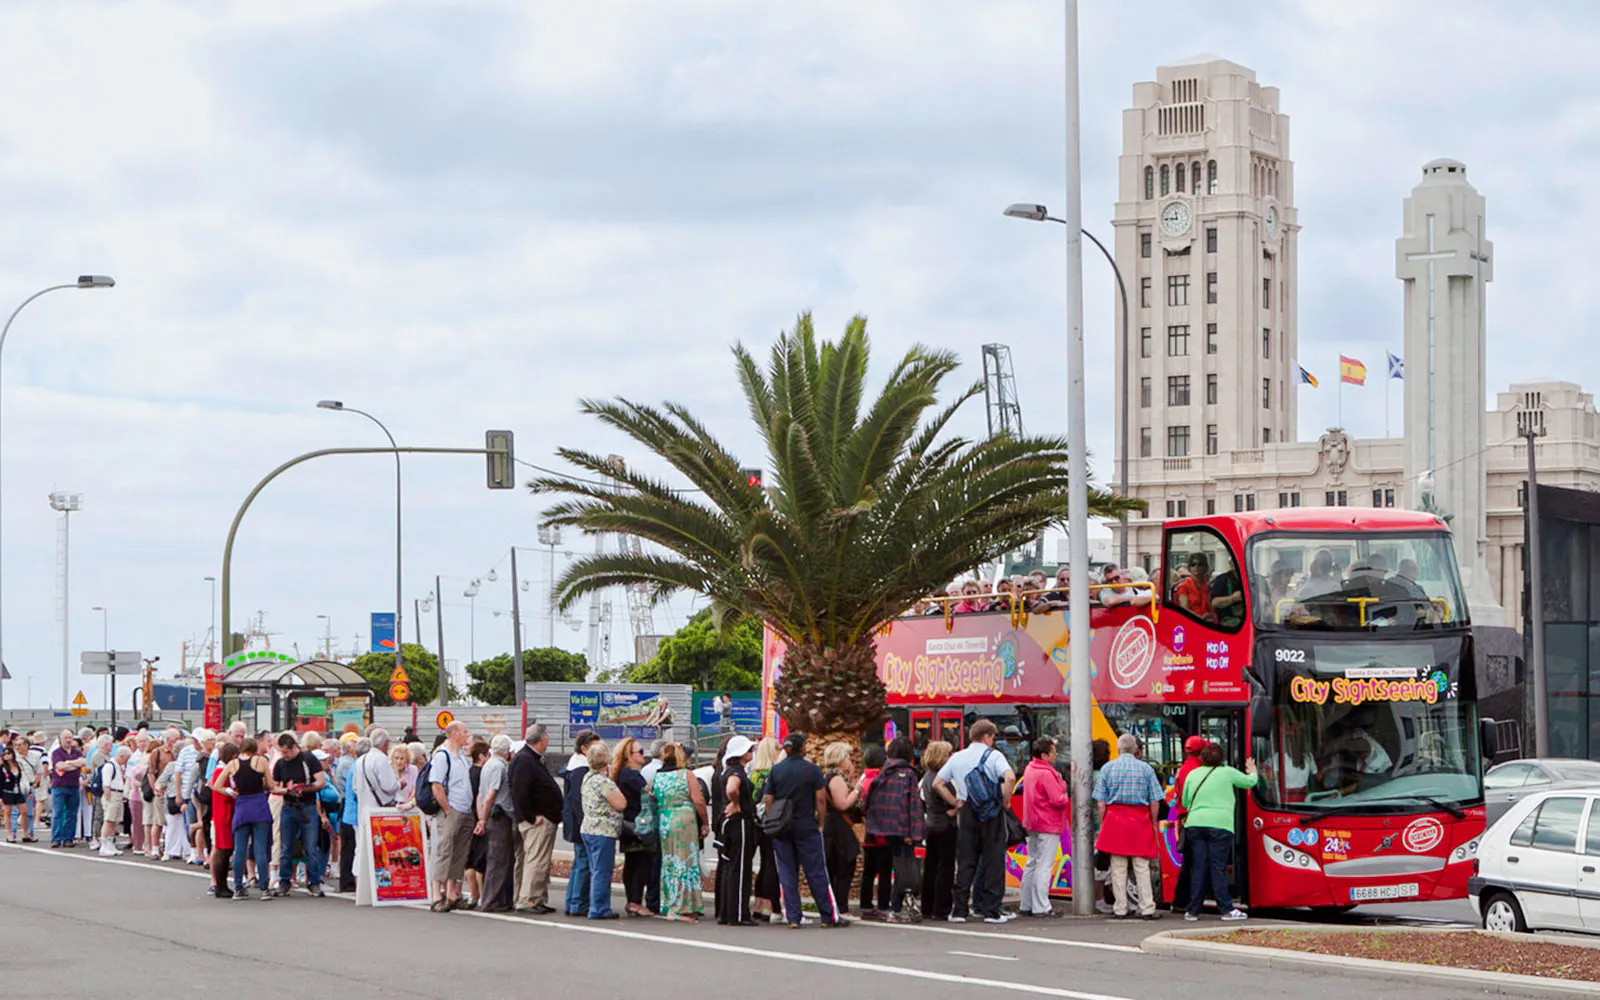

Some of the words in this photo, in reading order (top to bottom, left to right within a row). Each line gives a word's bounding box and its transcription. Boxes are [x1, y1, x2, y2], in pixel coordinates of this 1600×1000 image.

[1206, 642, 1219, 655] Hop
[1219, 640, 1229, 654] On
[1206, 656, 1218, 670] Hop
[1219, 656, 1229, 669] Off
[1275, 649, 1305, 663] 9022
[883, 652, 912, 697] City
[914, 653, 1005, 698] Sightseeing
[1291, 676, 1330, 705] City
[1332, 677, 1438, 705] Sightseeing
[1324, 837, 1339, 853] 24
[1356, 888, 1379, 899] 6688
[1380, 887, 1397, 897] HCJ
[1401, 884, 1417, 896] SP
